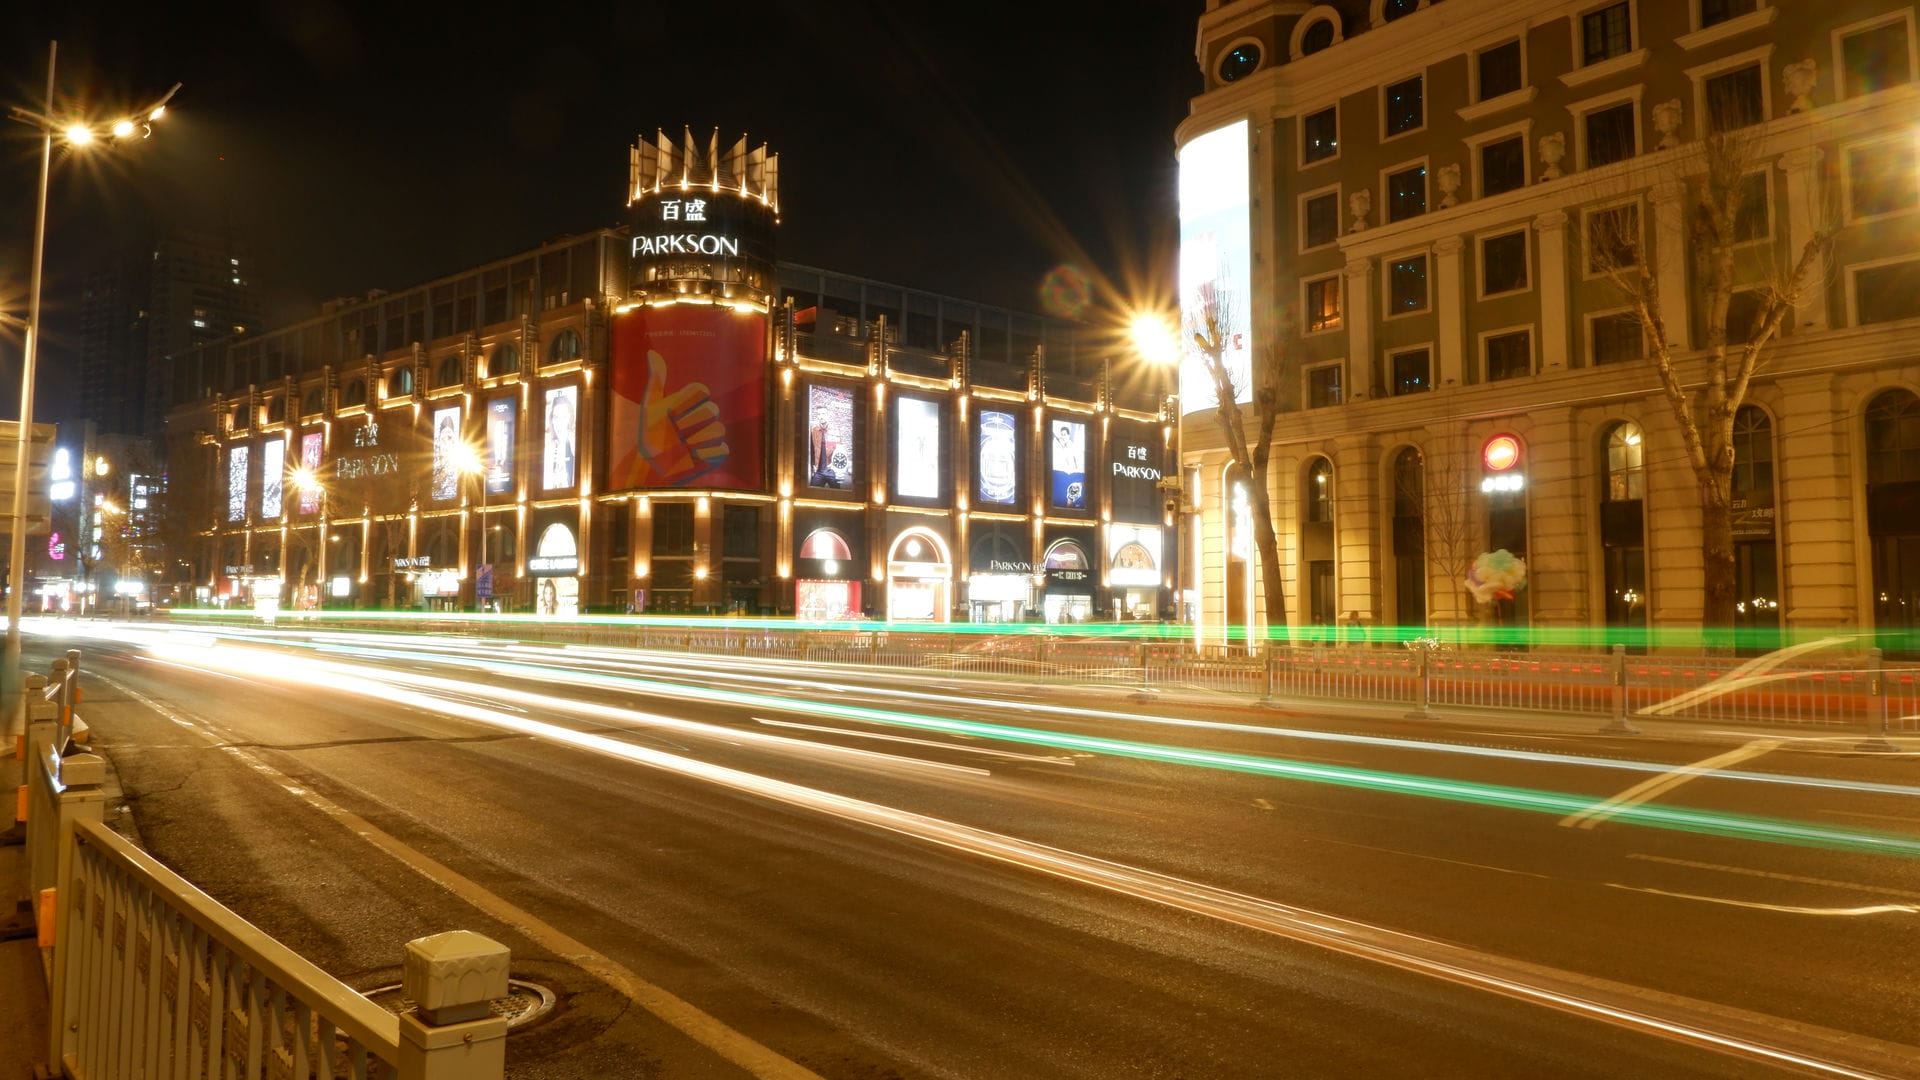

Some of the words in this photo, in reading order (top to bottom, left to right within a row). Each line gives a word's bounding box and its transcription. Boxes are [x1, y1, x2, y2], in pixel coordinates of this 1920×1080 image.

[660, 198, 707, 222] 百盛
[632, 233, 739, 258] PARKSON
[1127, 445, 1148, 461] 百盛
[1112, 462, 1161, 481] PARKSON
[990, 559, 1031, 571] PARKSON
